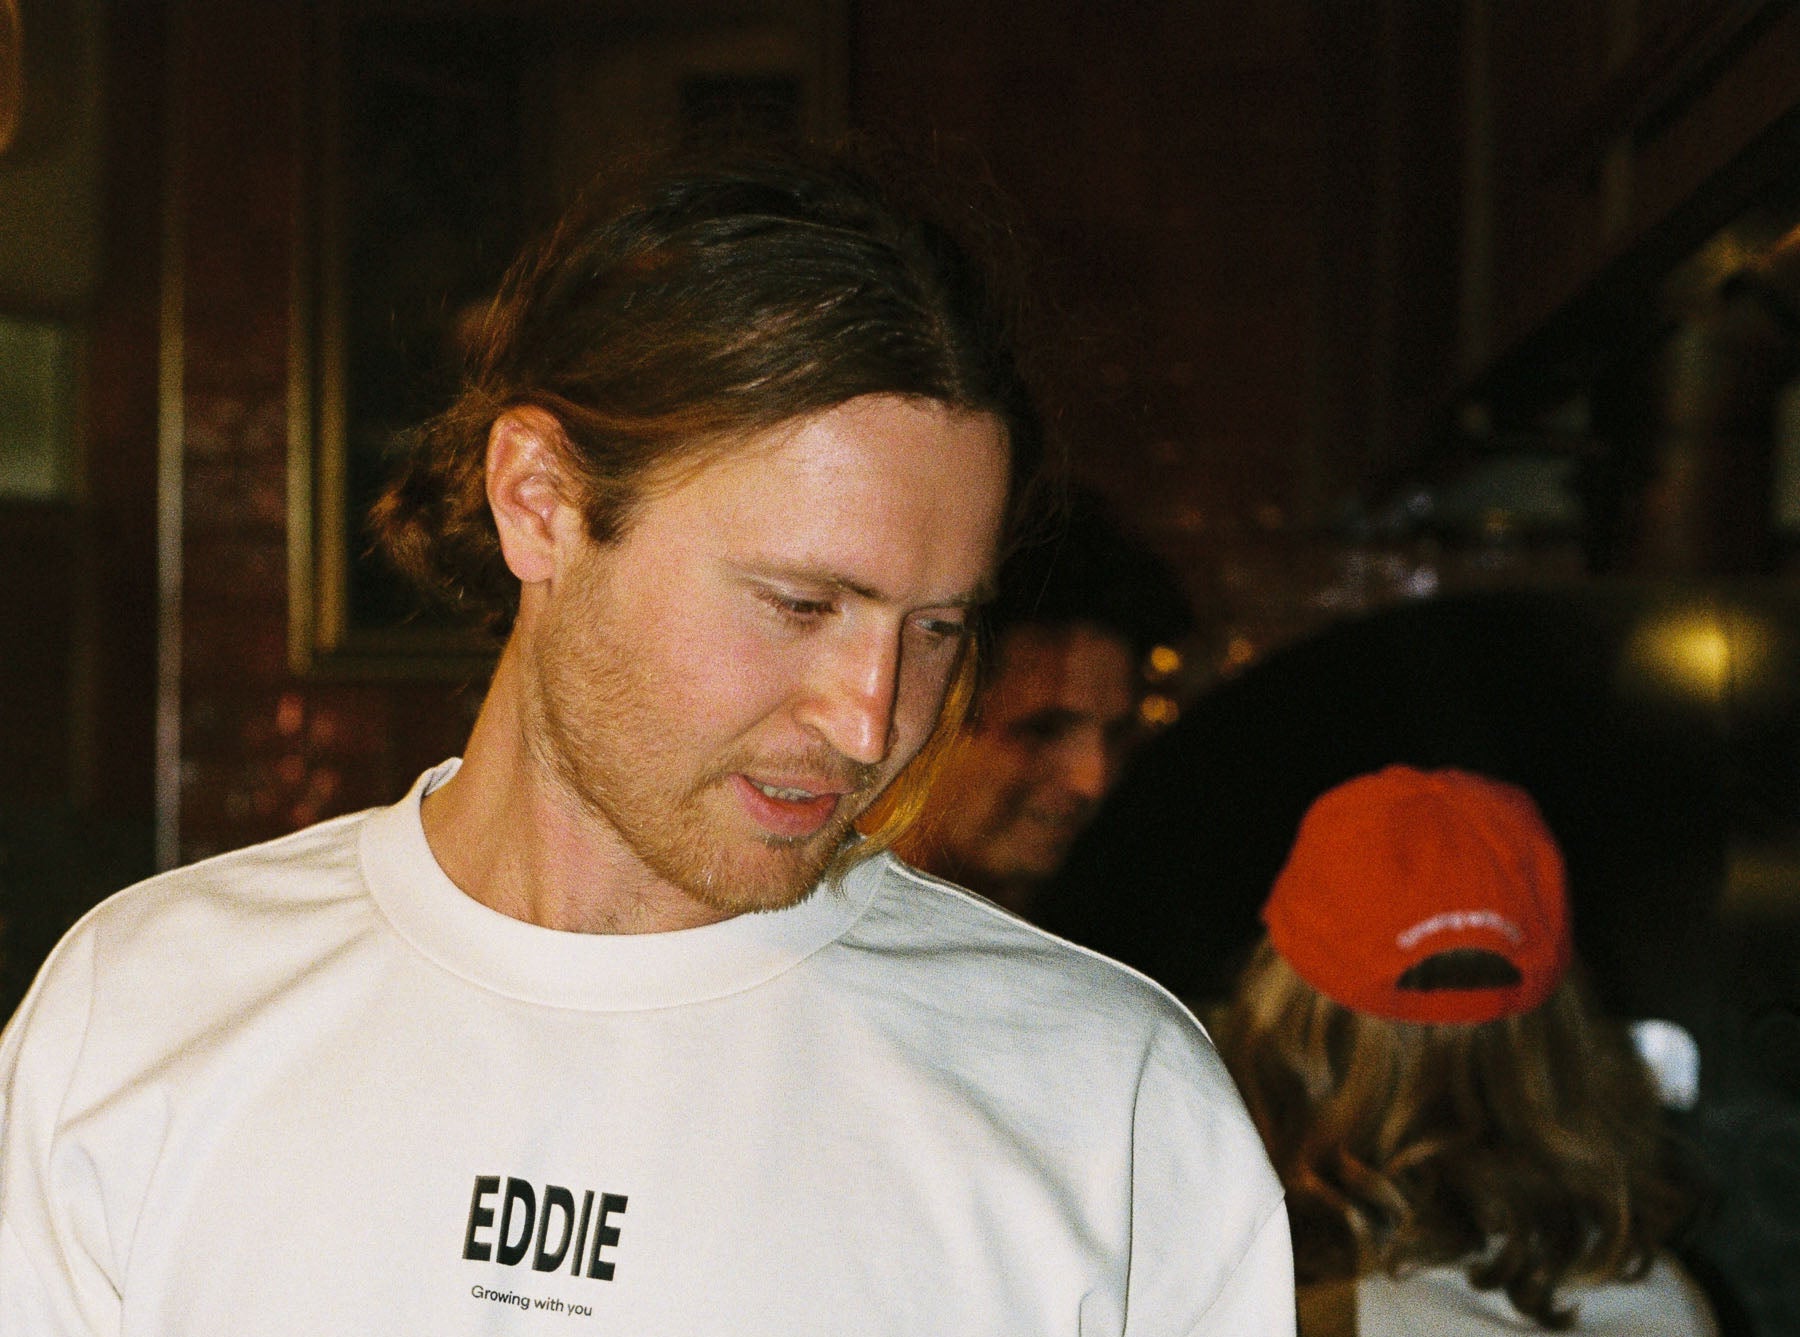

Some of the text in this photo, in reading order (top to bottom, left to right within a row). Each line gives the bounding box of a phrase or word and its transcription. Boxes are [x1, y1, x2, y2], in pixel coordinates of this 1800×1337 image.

[462, 1175, 629, 1281] EDDIE
[471, 1285, 592, 1316] Growing with you
